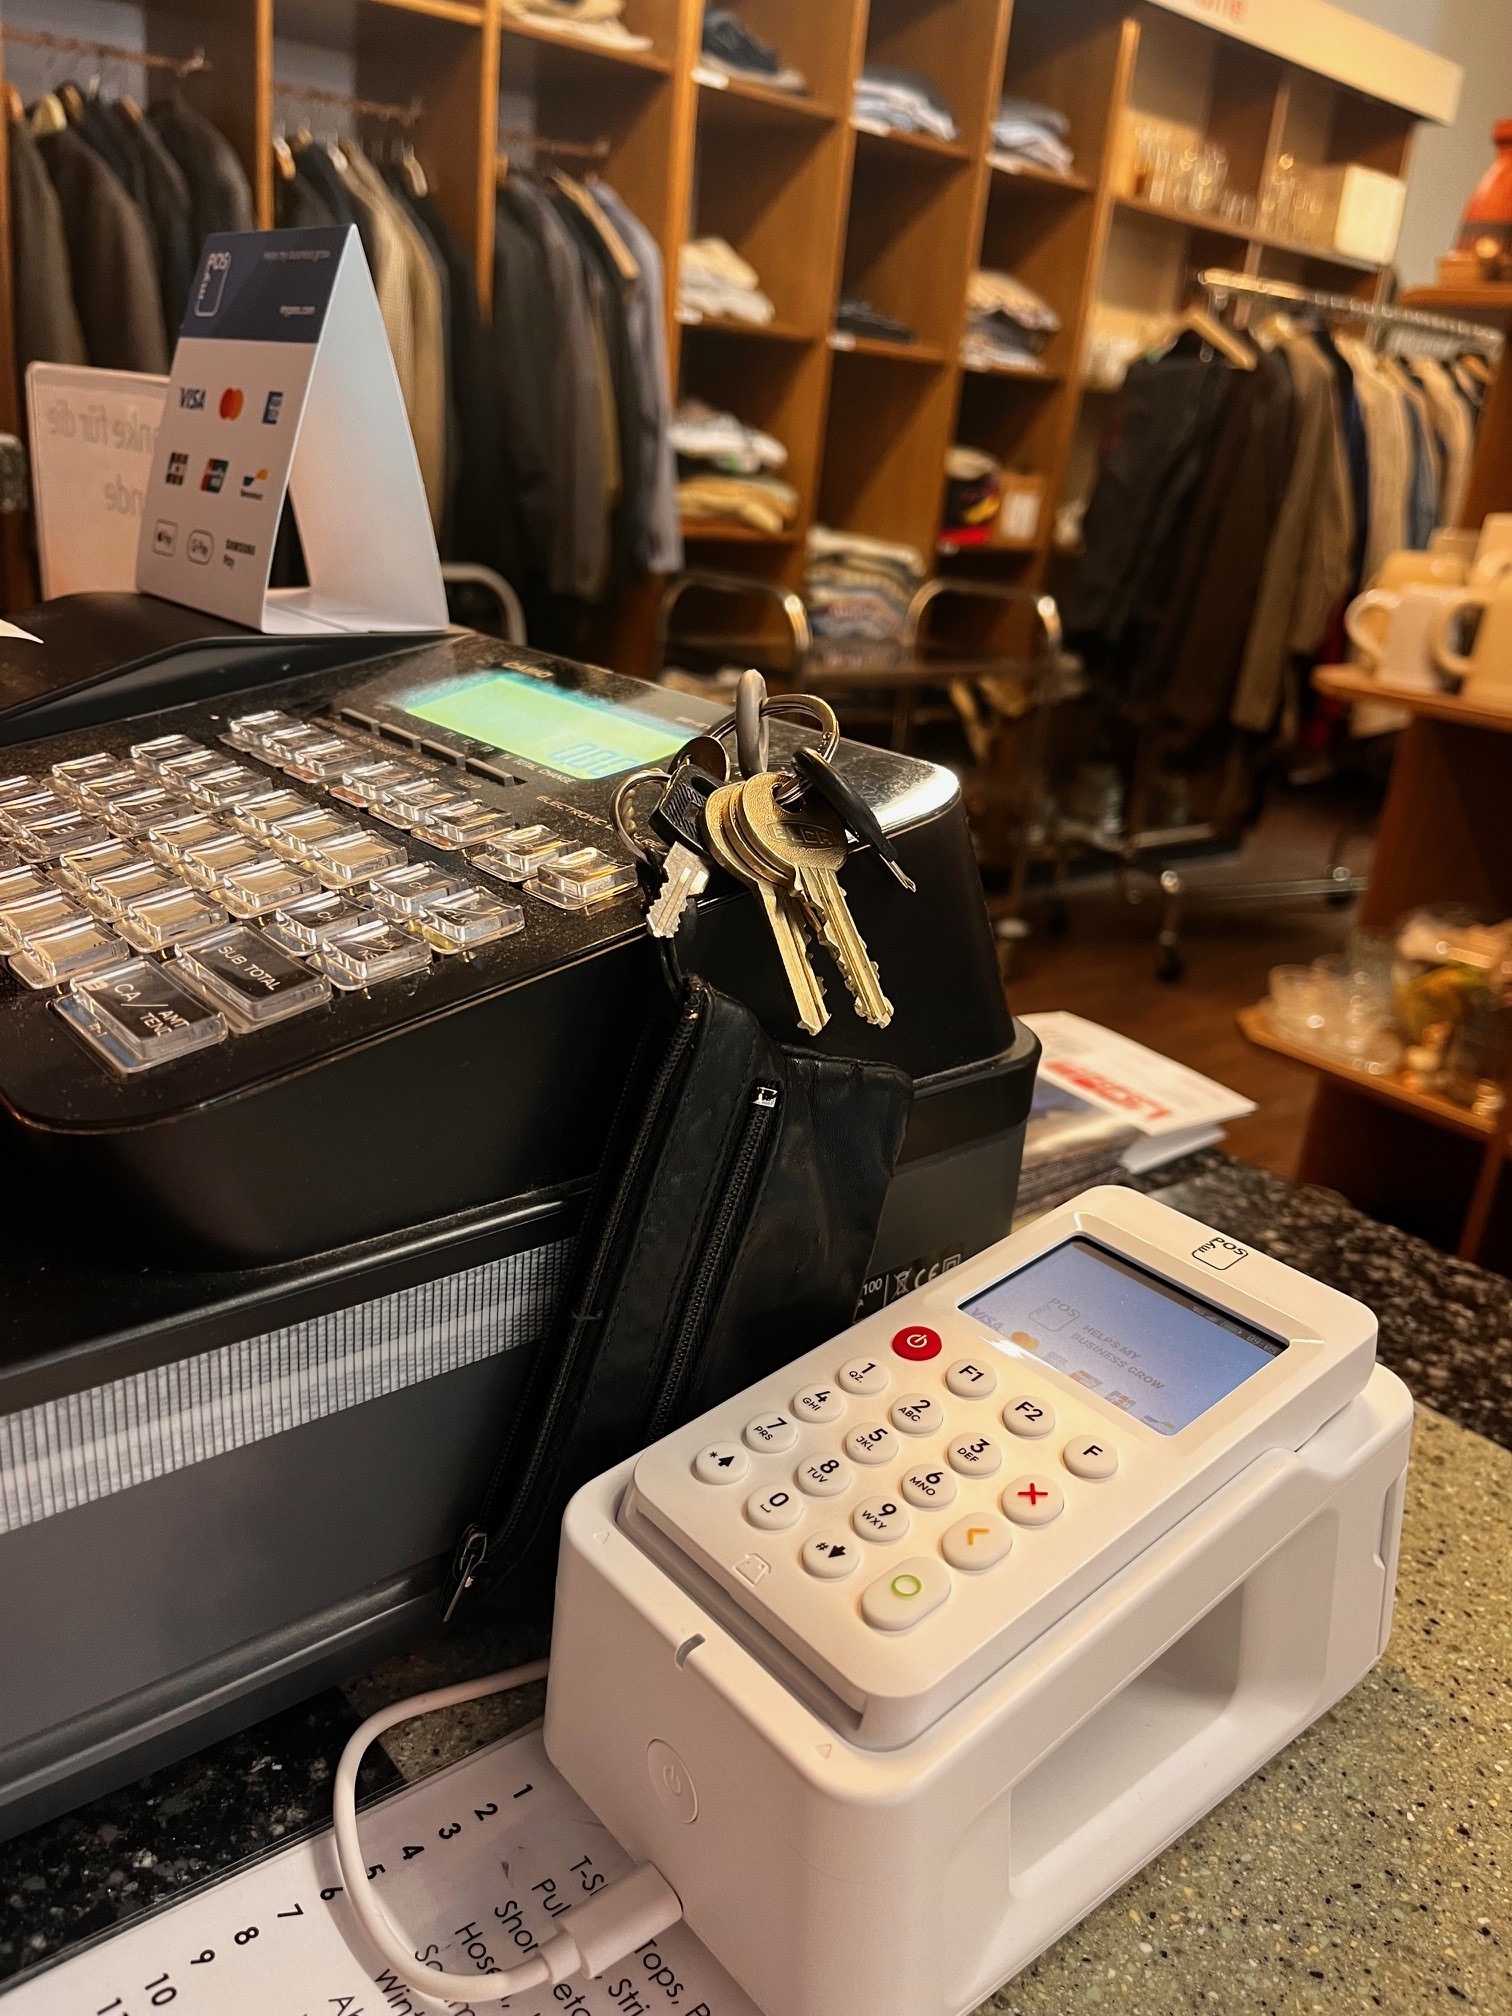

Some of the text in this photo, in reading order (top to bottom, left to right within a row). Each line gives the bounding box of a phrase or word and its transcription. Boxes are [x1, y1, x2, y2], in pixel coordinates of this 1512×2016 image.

[179, 387, 207, 411] VISA
[217, 945, 282, 991] SUB TOTAL
[157, 1009, 191, 1030] AMT
[971, 1306, 1004, 1332] VISA
[1082, 1324, 1142, 1361] HELPS MY
[861, 1362, 877, 1375] 1
[1070, 1332, 1166, 1391] BUSINESS GROW
[958, 1364, 985, 1383] F1
[801, 1396, 822, 1412] GHI
[814, 1390, 831, 1403] 4
[898, 1406, 922, 1422] ABC
[910, 1399, 932, 1414] 2
[1014, 1401, 1044, 1422] F2
[766, 1416, 788, 1430] 7
[753, 1425, 774, 1441] PRS
[868, 1427, 889, 1442] 5
[855, 1435, 874, 1452] JKL
[969, 1437, 991, 1454] 3
[1082, 1444, 1104, 1457] F
[956, 1446, 980, 1463] DEF
[806, 1466, 829, 1484] TUV
[819, 1459, 840, 1474] 8
[908, 1476, 937, 1497] MNO
[925, 1471, 945, 1486] 6
[768, 1492, 790, 1508] 0
[877, 1502, 898, 1518] 9
[861, 1509, 888, 1530] WXY
[512, 1783, 534, 1799] 1
[473, 1802, 499, 1822] 2
[438, 1822, 462, 1840] 3
[401, 1844, 425, 1861] 4
[367, 1863, 386, 1880] 5
[319, 1886, 344, 1901] 6
[276, 1903, 305, 1918] 7
[233, 1926, 260, 1946] 8
[190, 1949, 216, 1965] 9
[144, 1972, 178, 2008] 10
